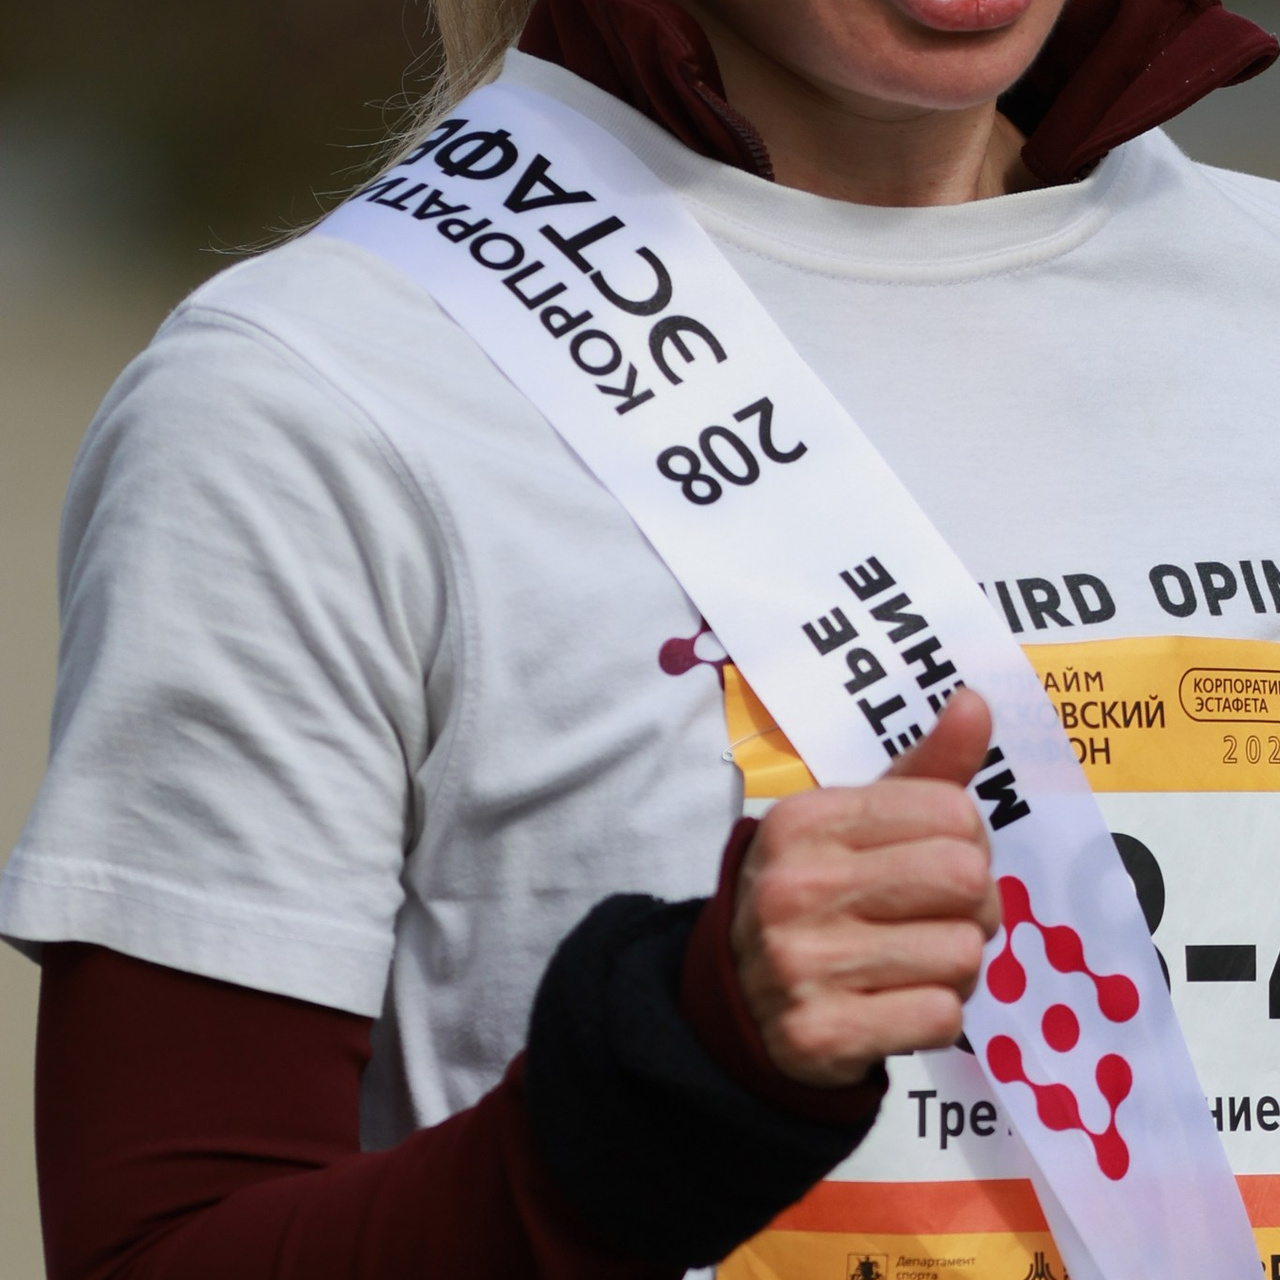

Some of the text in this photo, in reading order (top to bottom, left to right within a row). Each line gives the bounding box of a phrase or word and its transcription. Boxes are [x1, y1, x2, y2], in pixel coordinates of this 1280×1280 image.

[399, 119, 728, 386] ЭСТАФЕ
[350, 176, 656, 416] КОРПОРАТИ
[656, 396, 808, 506] 208
[978, 572, 1116, 634] IRD
[1037, 666, 1105, 693] АЙМ
[1195, 696, 1269, 713] ЭСТАФЕТА
[908, 1090, 1012, 1150] Тре
[895, 1256, 976, 1269] Департамент
